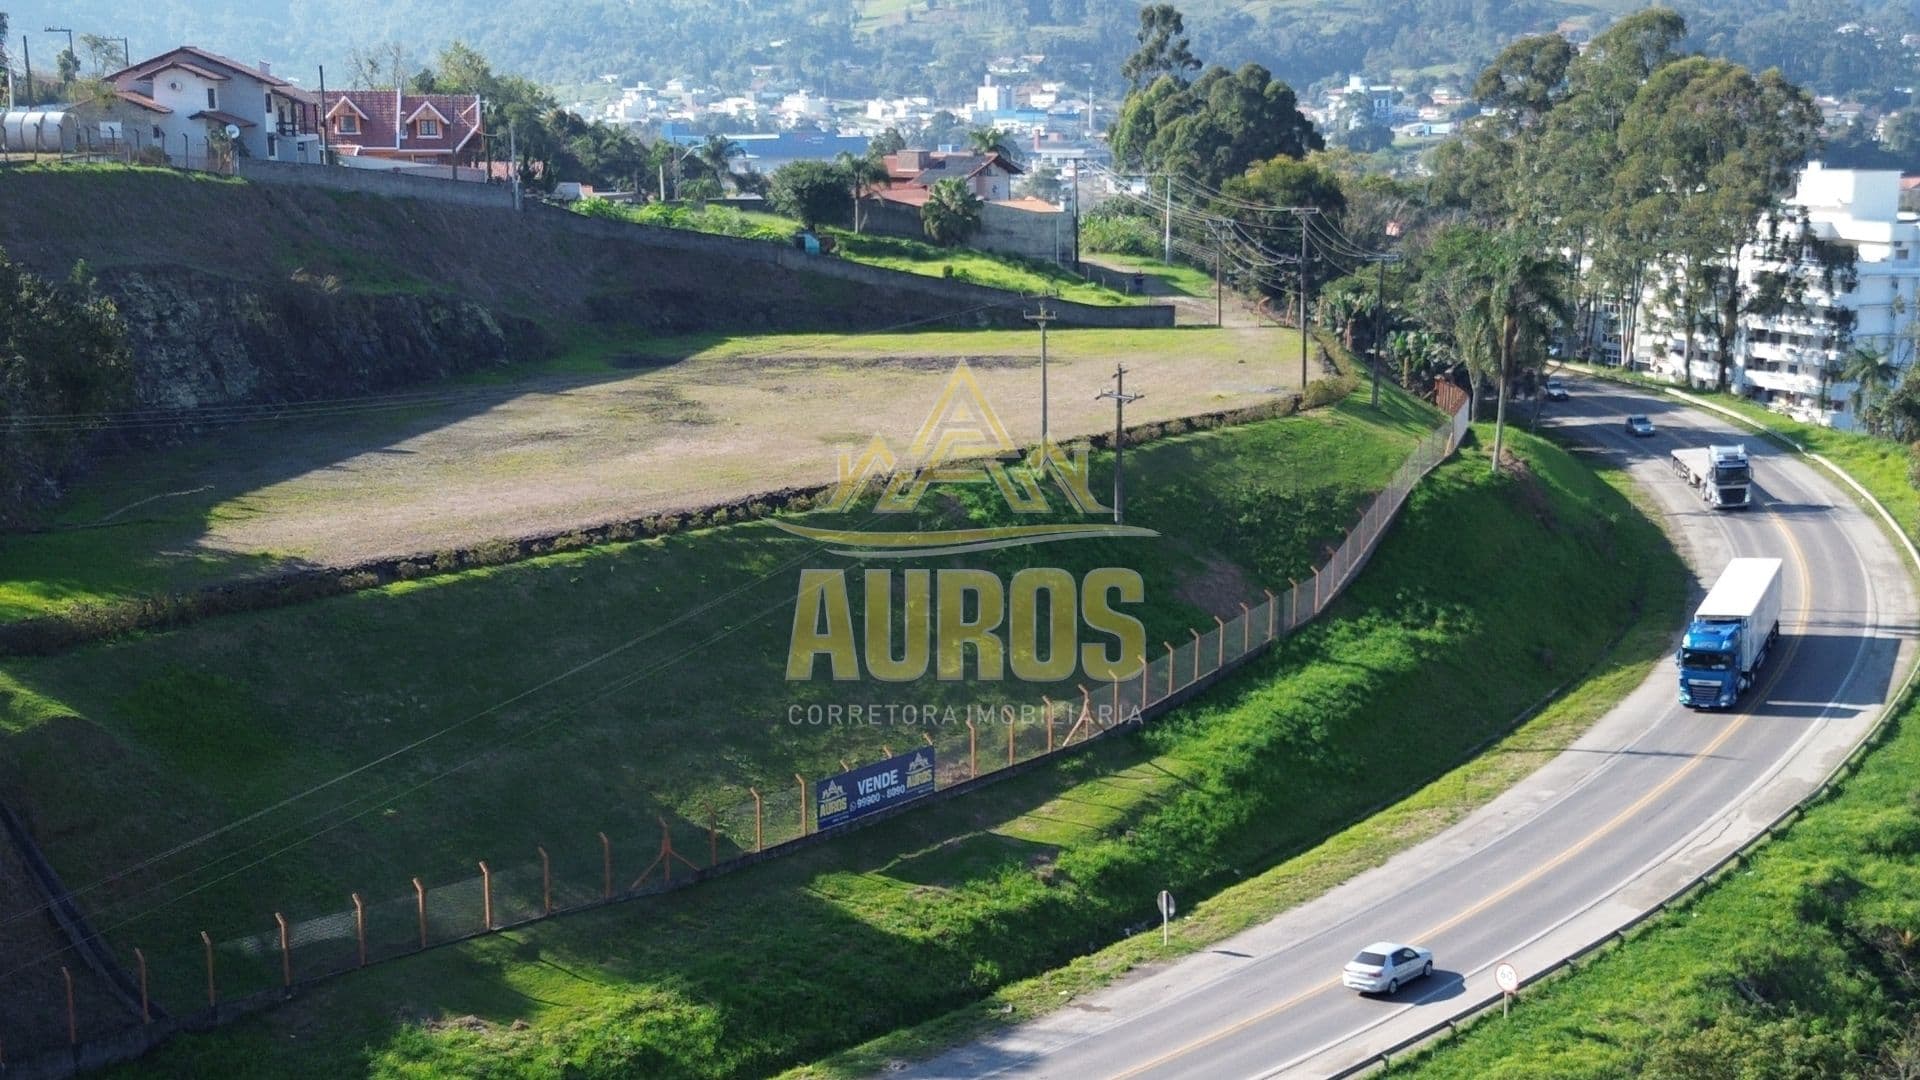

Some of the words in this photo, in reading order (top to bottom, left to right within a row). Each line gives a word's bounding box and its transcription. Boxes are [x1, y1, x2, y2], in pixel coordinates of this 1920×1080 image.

[857, 769, 899, 796] VENDE
[907, 768, 933, 789] AUROS
[820, 796, 848, 817] AUROS
